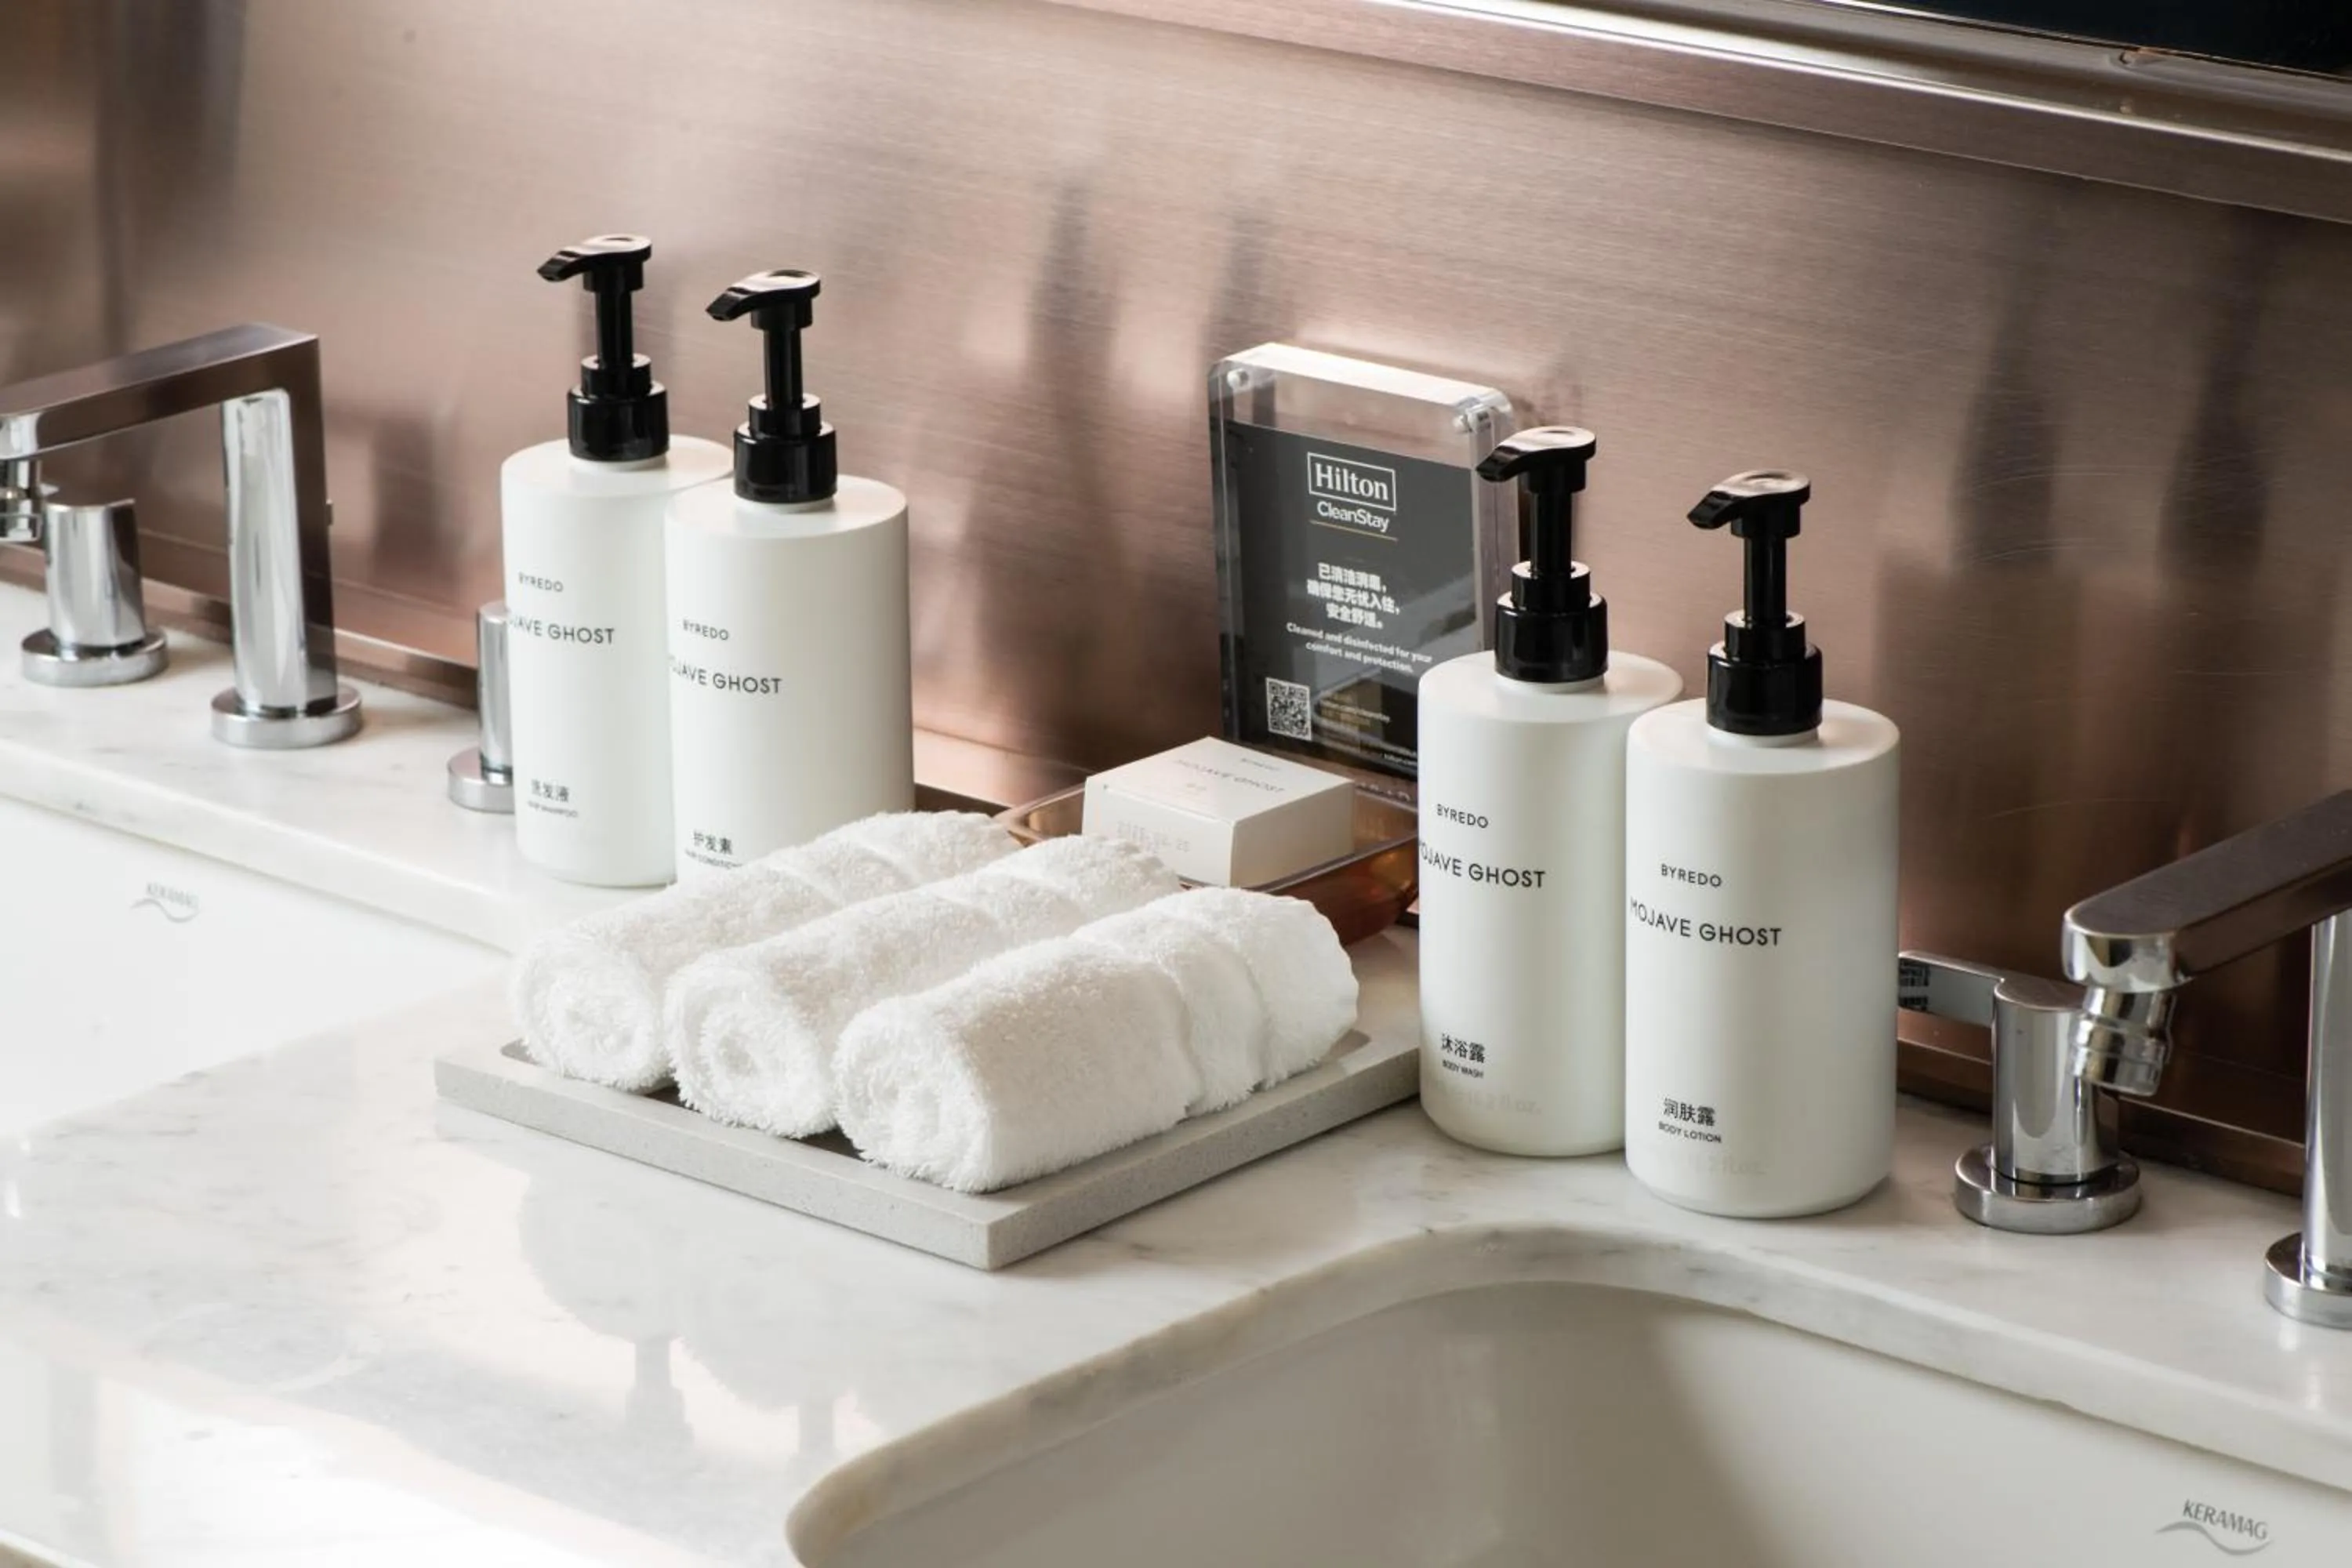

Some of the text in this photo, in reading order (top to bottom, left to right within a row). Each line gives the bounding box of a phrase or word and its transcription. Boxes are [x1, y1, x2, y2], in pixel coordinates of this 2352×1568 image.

[1315, 463, 1389, 501] Hilton
[1316, 500, 1390, 533] CleanStay
[518, 572, 564, 593] BYREDO
[547, 623, 615, 645] GHOST
[683, 619, 729, 641] BYREDO
[1287, 622, 1432, 664] Cleaned and disinfected for your
[1305, 641, 1342, 658] comfort
[1345, 650, 1363, 662] and
[713, 672, 782, 695] GHOST
[1437, 804, 1489, 829] BYREDO
[692, 829, 733, 855] 护发素
[1468, 863, 1545, 888] GHOST
[1661, 863, 1722, 887] BYREDO
[1630, 896, 1782, 946] MOJAVE GHOST
[1441, 1033, 1486, 1064] 沐浴露
[1443, 1059, 1459, 1073] BODY
[1663, 1098, 1716, 1127] 润肤露
[1658, 1121, 1722, 1144] BODY LOTION
[2183, 1499, 2268, 1541] KERAMAG
